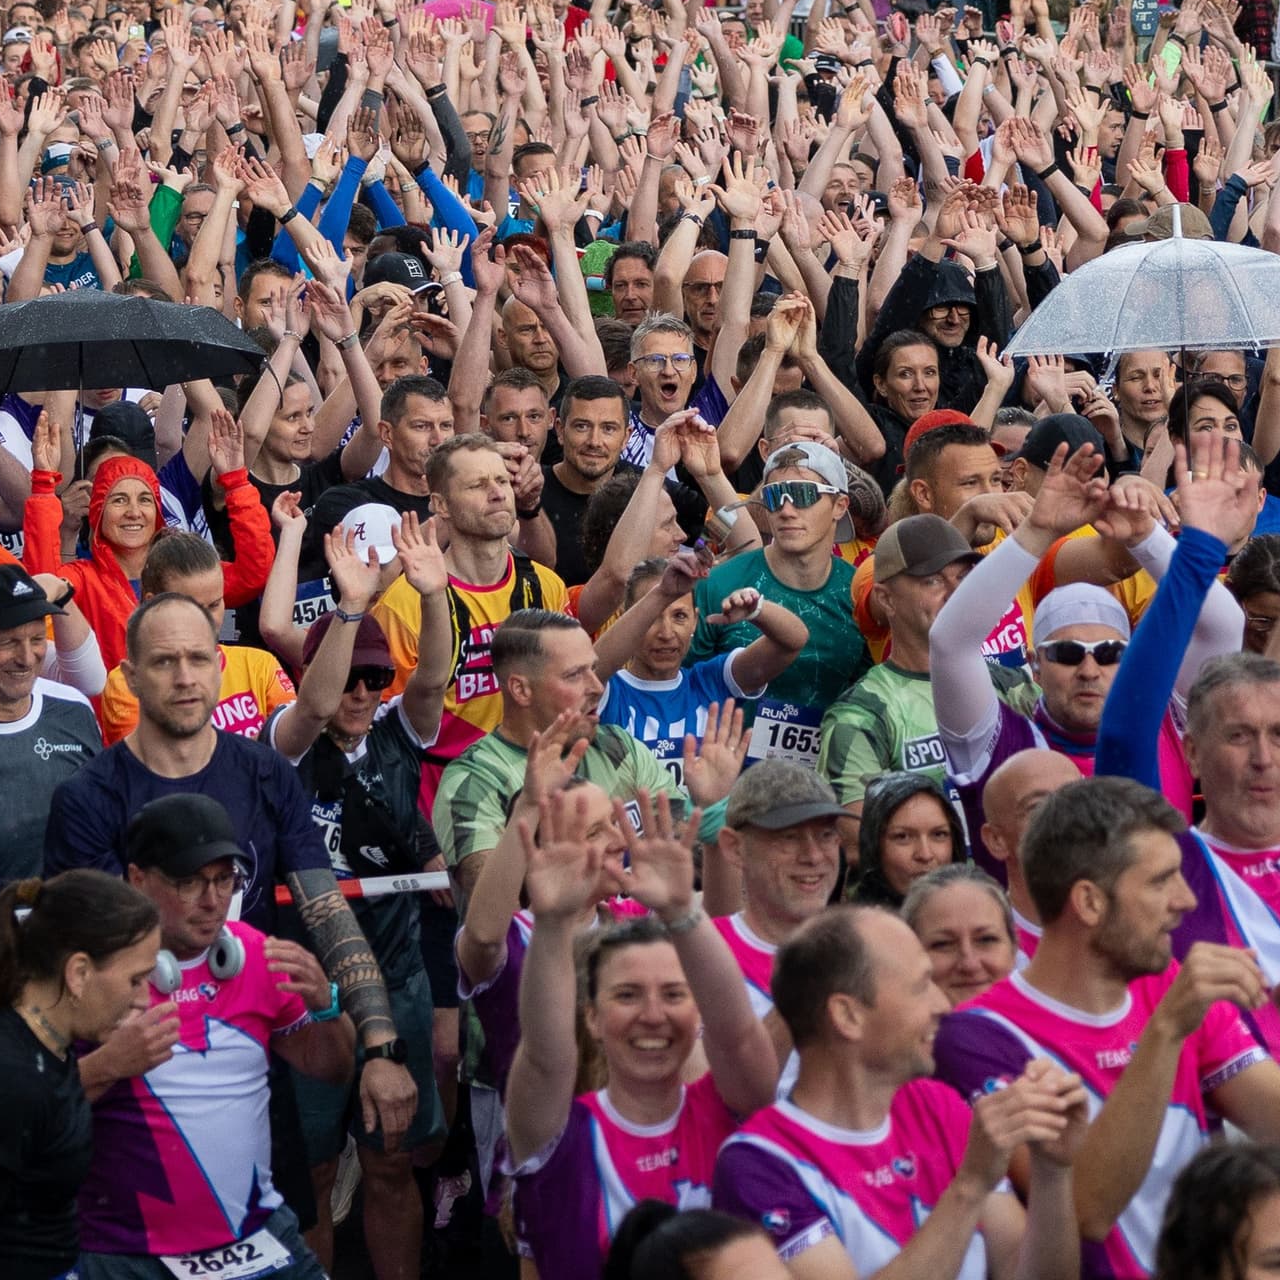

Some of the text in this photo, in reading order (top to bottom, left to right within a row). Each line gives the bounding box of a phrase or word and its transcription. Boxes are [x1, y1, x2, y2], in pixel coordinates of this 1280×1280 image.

[460, 672, 499, 700] BE
[761, 707, 789, 720] RUN
[909, 739, 945, 767] SPO
[312, 804, 337, 821] RUN
[180, 1243, 263, 1276] 2642
